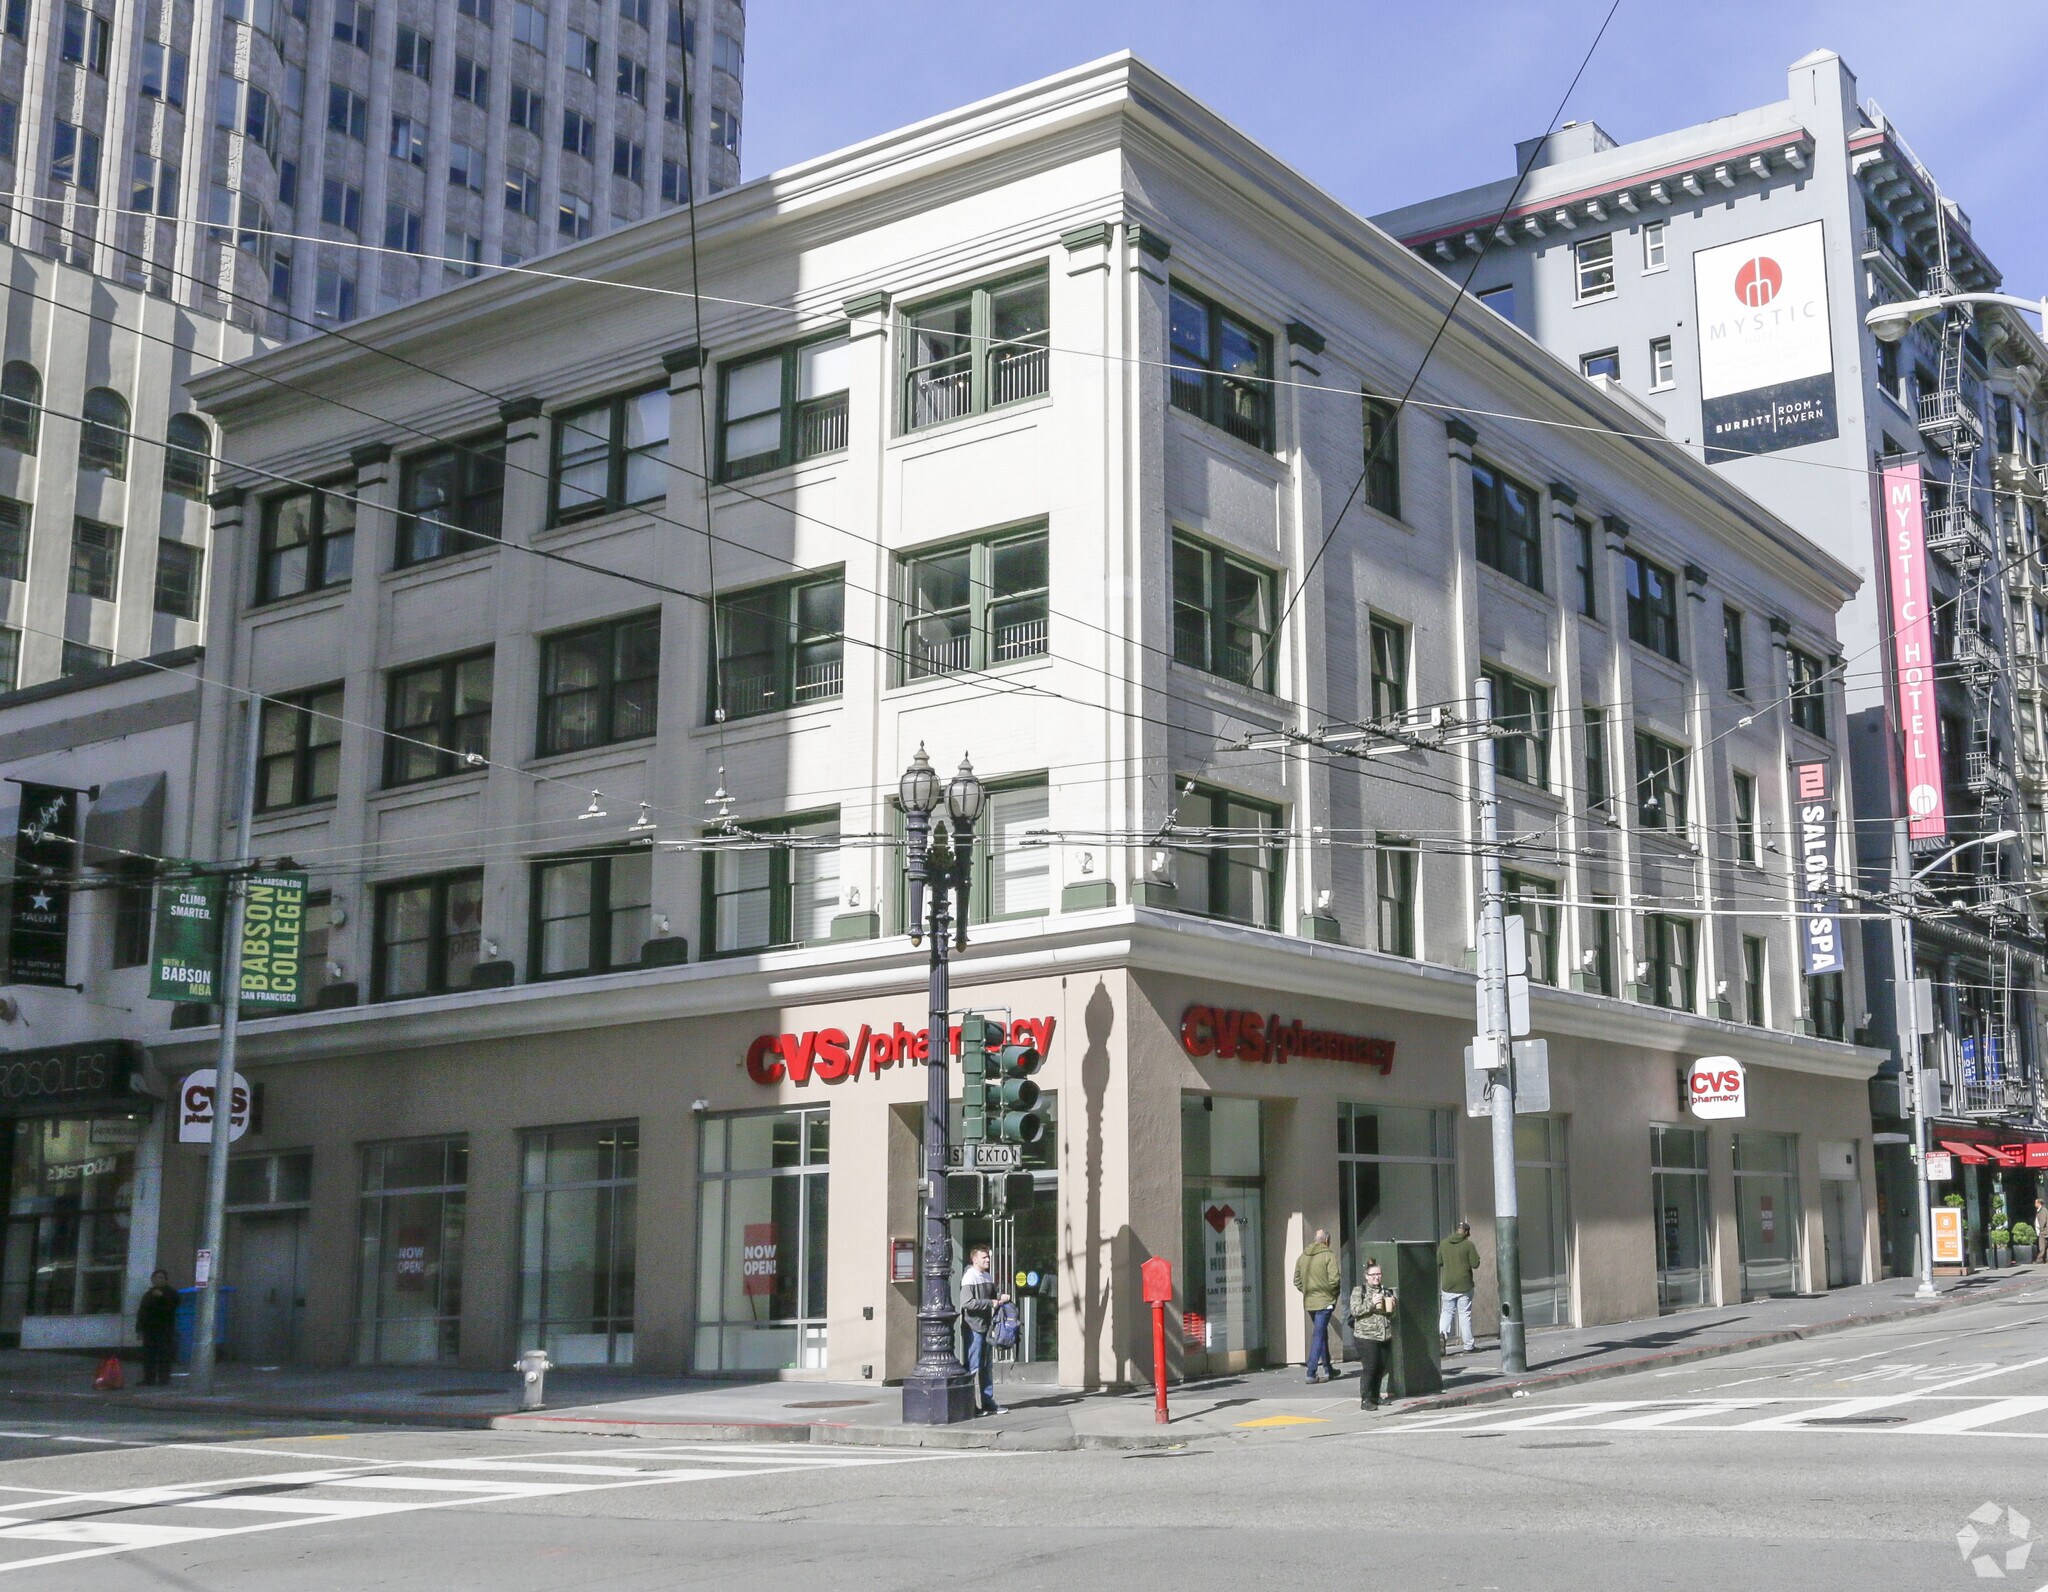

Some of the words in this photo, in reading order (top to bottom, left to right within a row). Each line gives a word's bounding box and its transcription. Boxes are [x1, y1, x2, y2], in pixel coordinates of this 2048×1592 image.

[1710, 300, 1816, 342] MYSTIC
[1778, 400, 1811, 415] ROOM
[1716, 414, 1771, 434] BURRITT
[1778, 408, 1823, 426] TAVERN
[1892, 484, 1917, 621] MYSTIC
[1904, 642, 1927, 759] HOTEL
[1802, 805, 1830, 893] SALON
[179, 893, 207, 906] CLIMB
[21, 912, 57, 924] TALENT
[170, 905, 212, 920] SMARTER.
[241, 885, 274, 991] BABSON
[271, 888, 302, 992] COLLEGE
[1810, 917, 1836, 971] SPA
[162, 958, 180, 967] WITH
[180, 959, 186, 967] A
[161, 966, 211, 984] BABSON
[188, 983, 211, 996] MBA
[241, 990, 255, 1001] SAN
[257, 992, 297, 1003] FRANCISCO
[1690, 1070, 1740, 1094] CVS
[1691, 1093, 1739, 1105] pharmacy
[952, 1149, 1017, 1162] SCKTON
[398, 1246, 424, 1259] NOW
[744, 1244, 777, 1260] NOW
[744, 1260, 777, 1275] OPEN!
[1207, 1287, 1219, 1296] SAN
[1220, 1285, 1252, 1295] FRANCISCO
